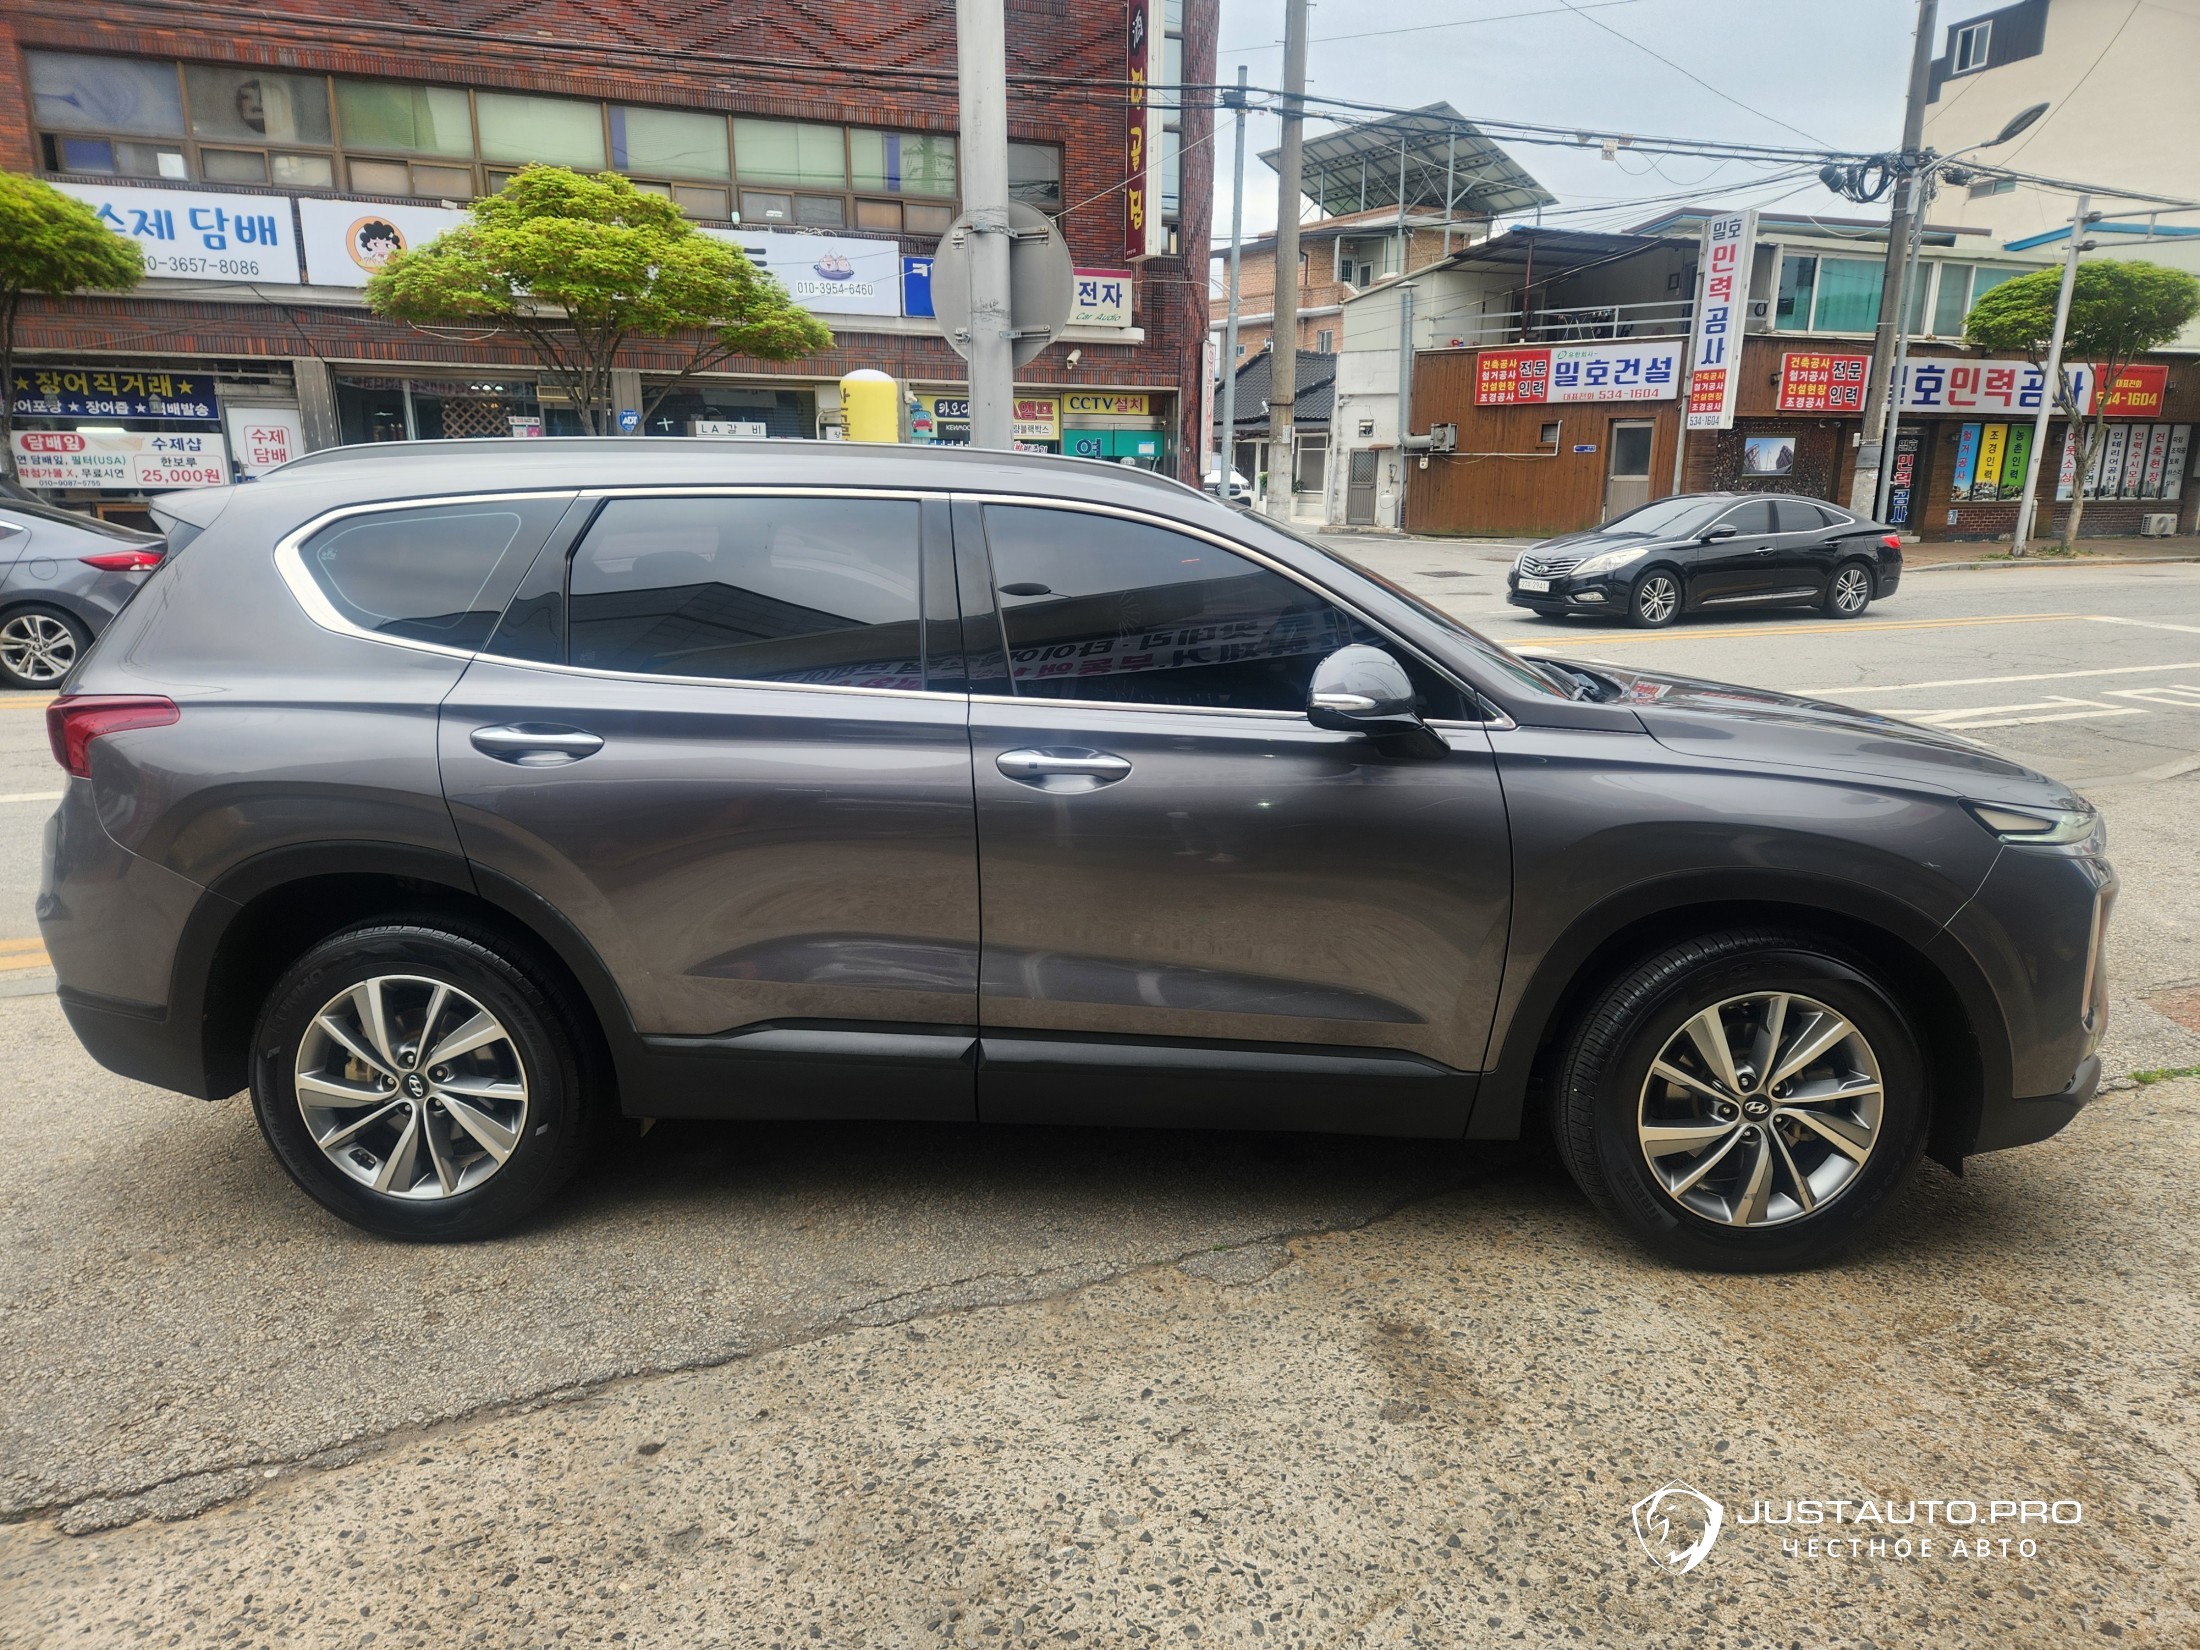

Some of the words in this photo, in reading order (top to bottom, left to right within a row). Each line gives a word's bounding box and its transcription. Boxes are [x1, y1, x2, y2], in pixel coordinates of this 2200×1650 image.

[188, 207, 278, 250] 담배
[797, 281, 873, 296] 010-3954-6460
[1078, 281, 1122, 308] 전자
[1076, 312, 1093, 320] Car
[1095, 312, 1121, 321] Audio
[1483, 358, 1517, 370] 건축공사
[1519, 359, 1547, 378] 전문
[1791, 357, 1830, 369] 건축공사
[1482, 370, 1516, 380] 철거공사
[1695, 371, 1725, 381] 건축공사
[1789, 370, 1829, 382] 철거공사
[1832, 360, 1862, 381] 전문
[34, 371, 173, 398] 장어직거래
[1481, 381, 1516, 392] 건설현장
[1518, 379, 1545, 398] 인력
[1787, 383, 1827, 395] 건설현장
[2115, 379, 2142, 388] 대표전화
[1479, 392, 1515, 402] 조경공사
[1599, 388, 1659, 400] 534-1604
[1829, 385, 1859, 406] 인력
[13, 399, 62, 413] 어포장
[86, 400, 129, 415] 장어즙
[1069, 397, 1143, 413] CCTV설치
[1691, 402, 1721, 412] 조경공사
[1785, 397, 1825, 408] 조경공사
[622, 416, 638, 425] ADT
[1690, 415, 1720, 426] 534-1604
[702, 423, 719, 433] LA
[726, 423, 761, 434] 갈비
[26, 434, 81, 451] 담배잎
[251, 429, 285, 445] 수제
[151, 437, 203, 452] 수제샵
[71, 455, 126, 465] 필터(USA)
[254, 448, 287, 463] 담배
[1955, 430, 1972, 480] 철거공사
[1984, 430, 1999, 480] 조경인력
[2009, 430, 2025, 480] 농촌인력
[2149, 432, 2165, 483] 건축현장
[160, 457, 198, 468] 한보루
[82, 468, 125, 478] 무료시연
[141, 468, 221, 485] 25,000원
